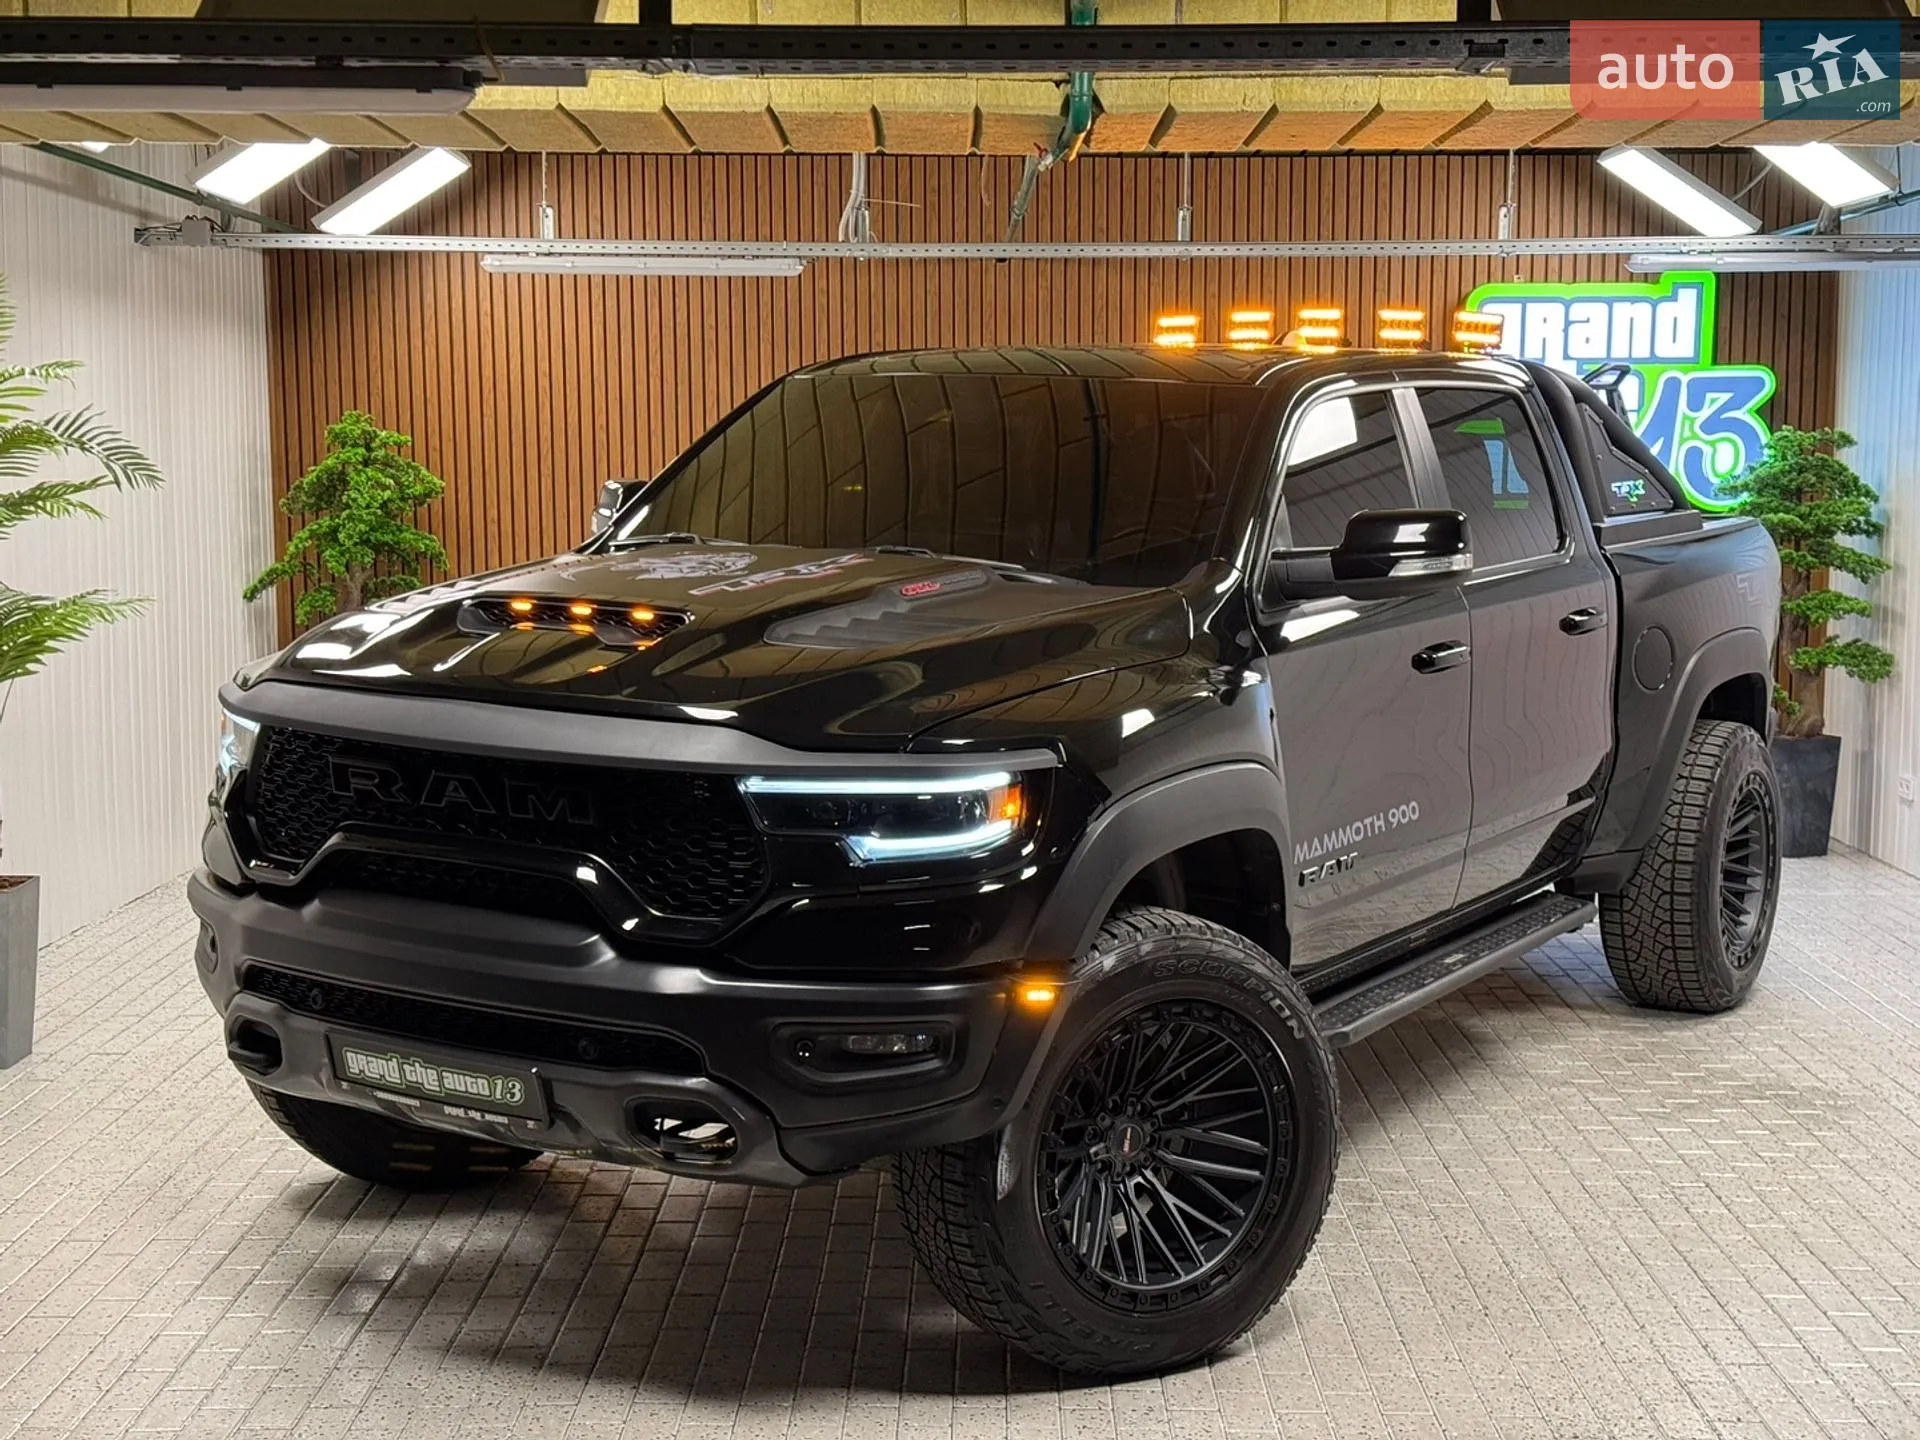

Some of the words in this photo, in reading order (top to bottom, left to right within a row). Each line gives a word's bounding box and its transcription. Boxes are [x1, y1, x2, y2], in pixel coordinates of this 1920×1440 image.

[328, 753, 598, 826] RAM
[1294, 812, 1386, 865] MAMMOTH
[1388, 801, 1420, 829] 900
[1153, 958, 1305, 1040] SCORPION
